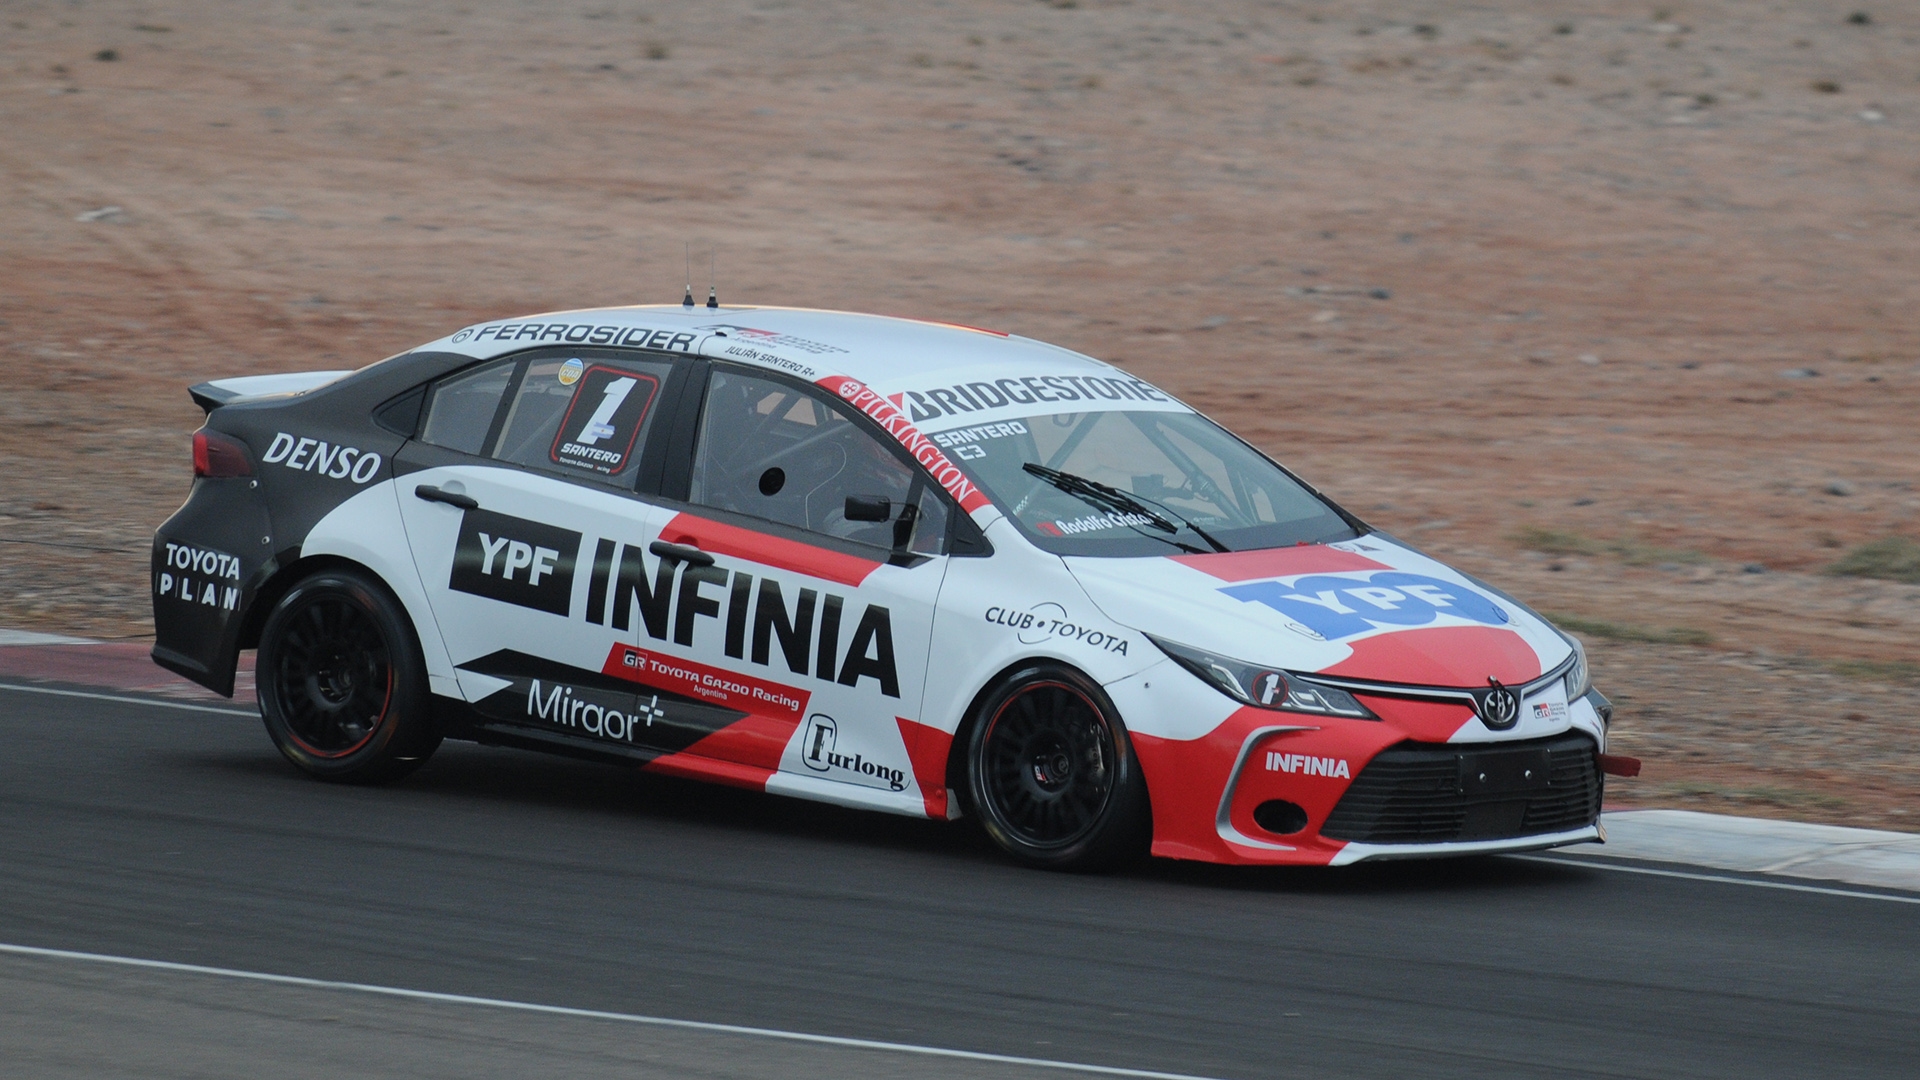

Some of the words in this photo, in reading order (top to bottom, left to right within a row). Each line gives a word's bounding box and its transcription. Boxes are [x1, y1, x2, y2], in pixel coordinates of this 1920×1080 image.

[474, 323, 698, 351] FERROSIDER
[724, 345, 759, 360] JULIÁN
[758, 353, 804, 372] SANTERO
[801, 366, 816, 377] A+
[576, 376, 638, 445] 1
[888, 376, 1169, 423] BRIDGESTONE
[561, 442, 622, 464] SANTERO
[851, 389, 979, 504] PILKINGTON
[934, 421, 1028, 448] SANTERO
[262, 432, 382, 484] DENSO
[1055, 514, 1113, 535] Rodolfo
[166, 543, 241, 581] TOYOTA
[478, 531, 560, 587] YPF
[585, 537, 901, 700] INFINIA
[1279, 584, 1459, 615] YPF
[985, 606, 1034, 630] CLUB
[1049, 619, 1129, 657] TOYOTA
[623, 653, 647, 669] GR
[649, 659, 700, 683] TOYOTA
[702, 674, 750, 696] GAZOO
[752, 687, 800, 712] Racing
[693, 684, 728, 701] Argentina
[1261, 673, 1280, 705] 1
[808, 723, 906, 792] Furlong
[1265, 751, 1351, 780] INFINIA
